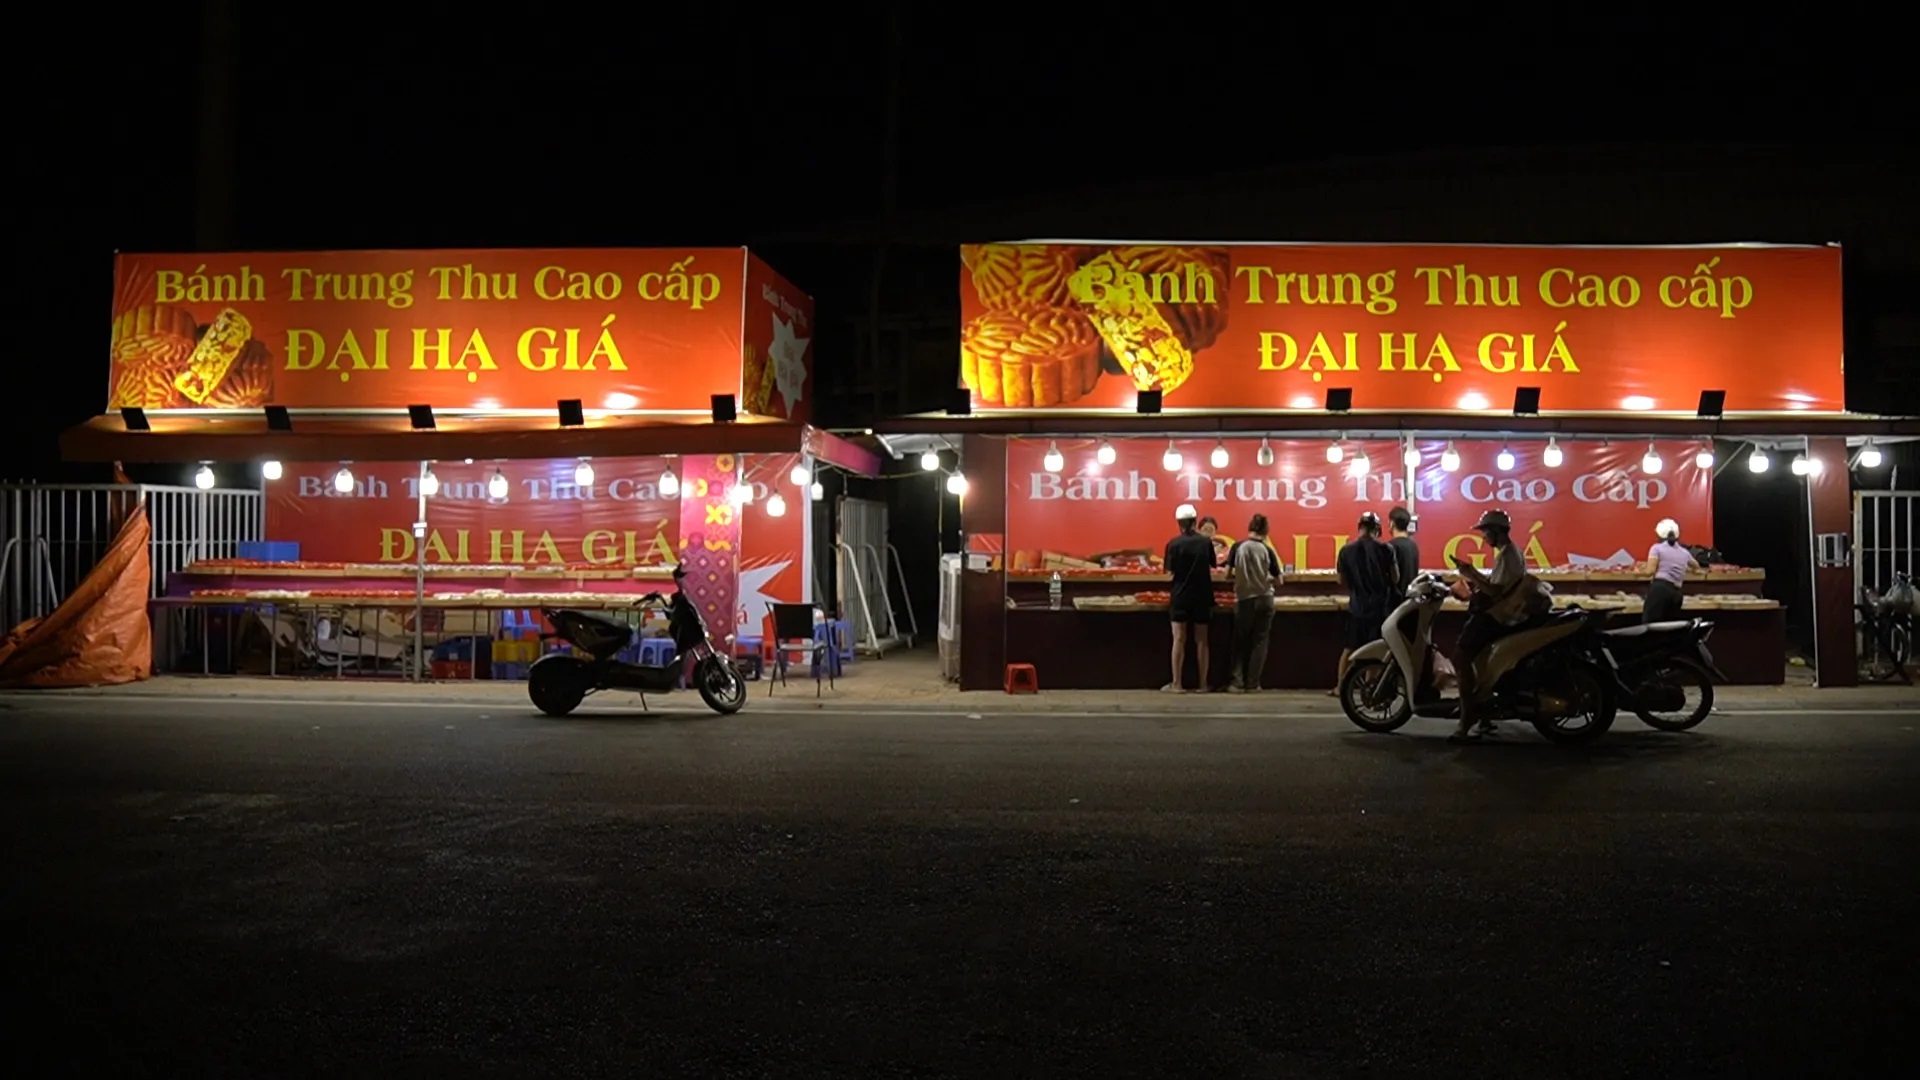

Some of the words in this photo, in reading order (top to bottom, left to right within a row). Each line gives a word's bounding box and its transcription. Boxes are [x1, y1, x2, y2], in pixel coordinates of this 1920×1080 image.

[155, 264, 266, 303] Bánh
[281, 267, 414, 309] Trung
[429, 264, 518, 300] Thu
[534, 266, 622, 301] Cao
[638, 256, 721, 309] cấp
[1079, 259, 1217, 304] Bánh
[1235, 266, 1398, 315] Trung
[1414, 264, 1521, 306] Thu
[1538, 267, 1641, 308] Cao
[1659, 256, 1753, 318] cấp
[284, 328, 392, 383] ĐẠI
[409, 328, 498, 383] HẠ
[516, 313, 628, 372] GIÁ
[1258, 331, 1360, 383] ĐẠI
[1378, 331, 1461, 383] HẠ
[1477, 320, 1580, 373] GIÁ
[521, 477, 596, 500] Thu
[1028, 467, 1159, 501] Bánh
[1175, 472, 1328, 509] Trung
[1344, 471, 1443, 502] Thu
[1460, 473, 1556, 503] Cao
[582, 518, 679, 565] GIÁ
